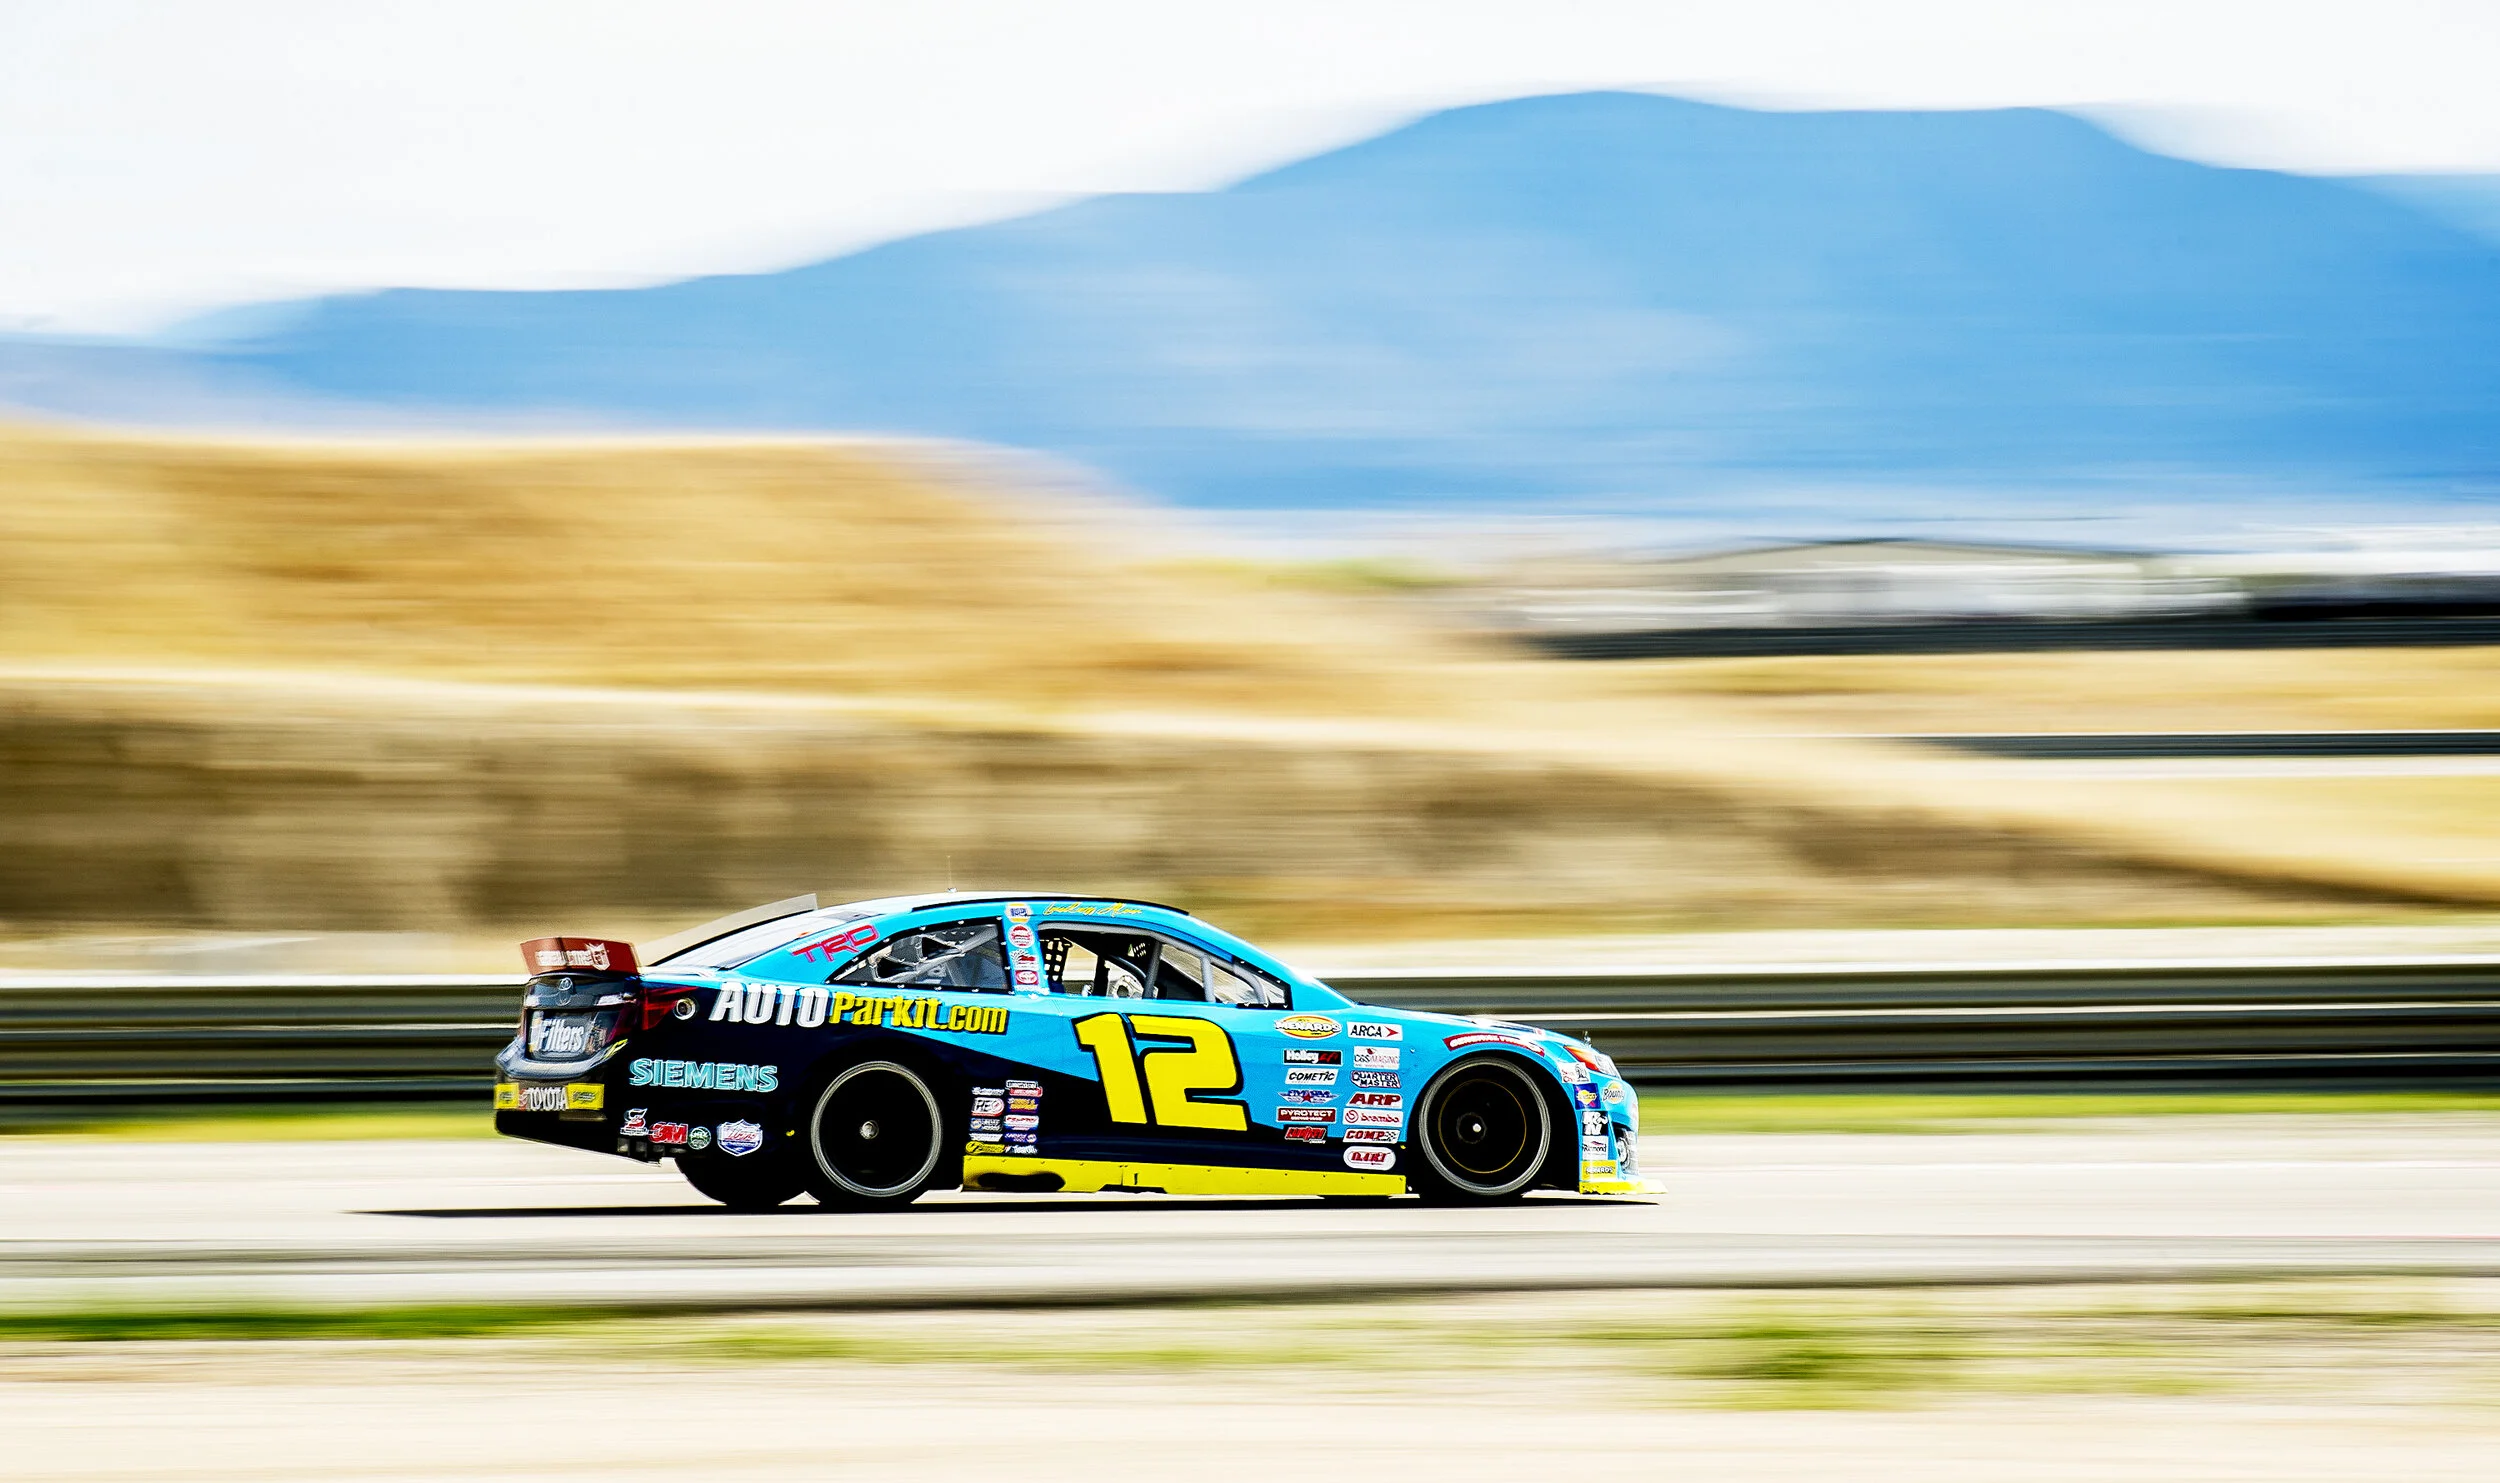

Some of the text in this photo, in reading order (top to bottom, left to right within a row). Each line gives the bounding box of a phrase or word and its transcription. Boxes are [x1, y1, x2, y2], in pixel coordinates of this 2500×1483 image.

[792, 924, 878, 962] TRD
[708, 982, 1009, 1034] AUTOParkit.com
[1275, 1021, 1342, 1033] MENARDS
[1350, 1024, 1383, 1037] ARCA
[1286, 1049, 1319, 1064] Holley
[629, 1058, 779, 1093] SIEMENS
[1072, 1012, 1250, 1132] 12
[1288, 1071, 1336, 1082] COMETIC
[1352, 1070, 1397, 1081] QUARTER
[527, 1086, 569, 1112] TOYOTA
[1349, 1093, 1401, 1106] ARP
[1280, 1109, 1333, 1117] PYROTECT
[1361, 1112, 1400, 1123] brembo
[650, 1122, 689, 1144] 3M
[1346, 1129, 1385, 1140] COMP
